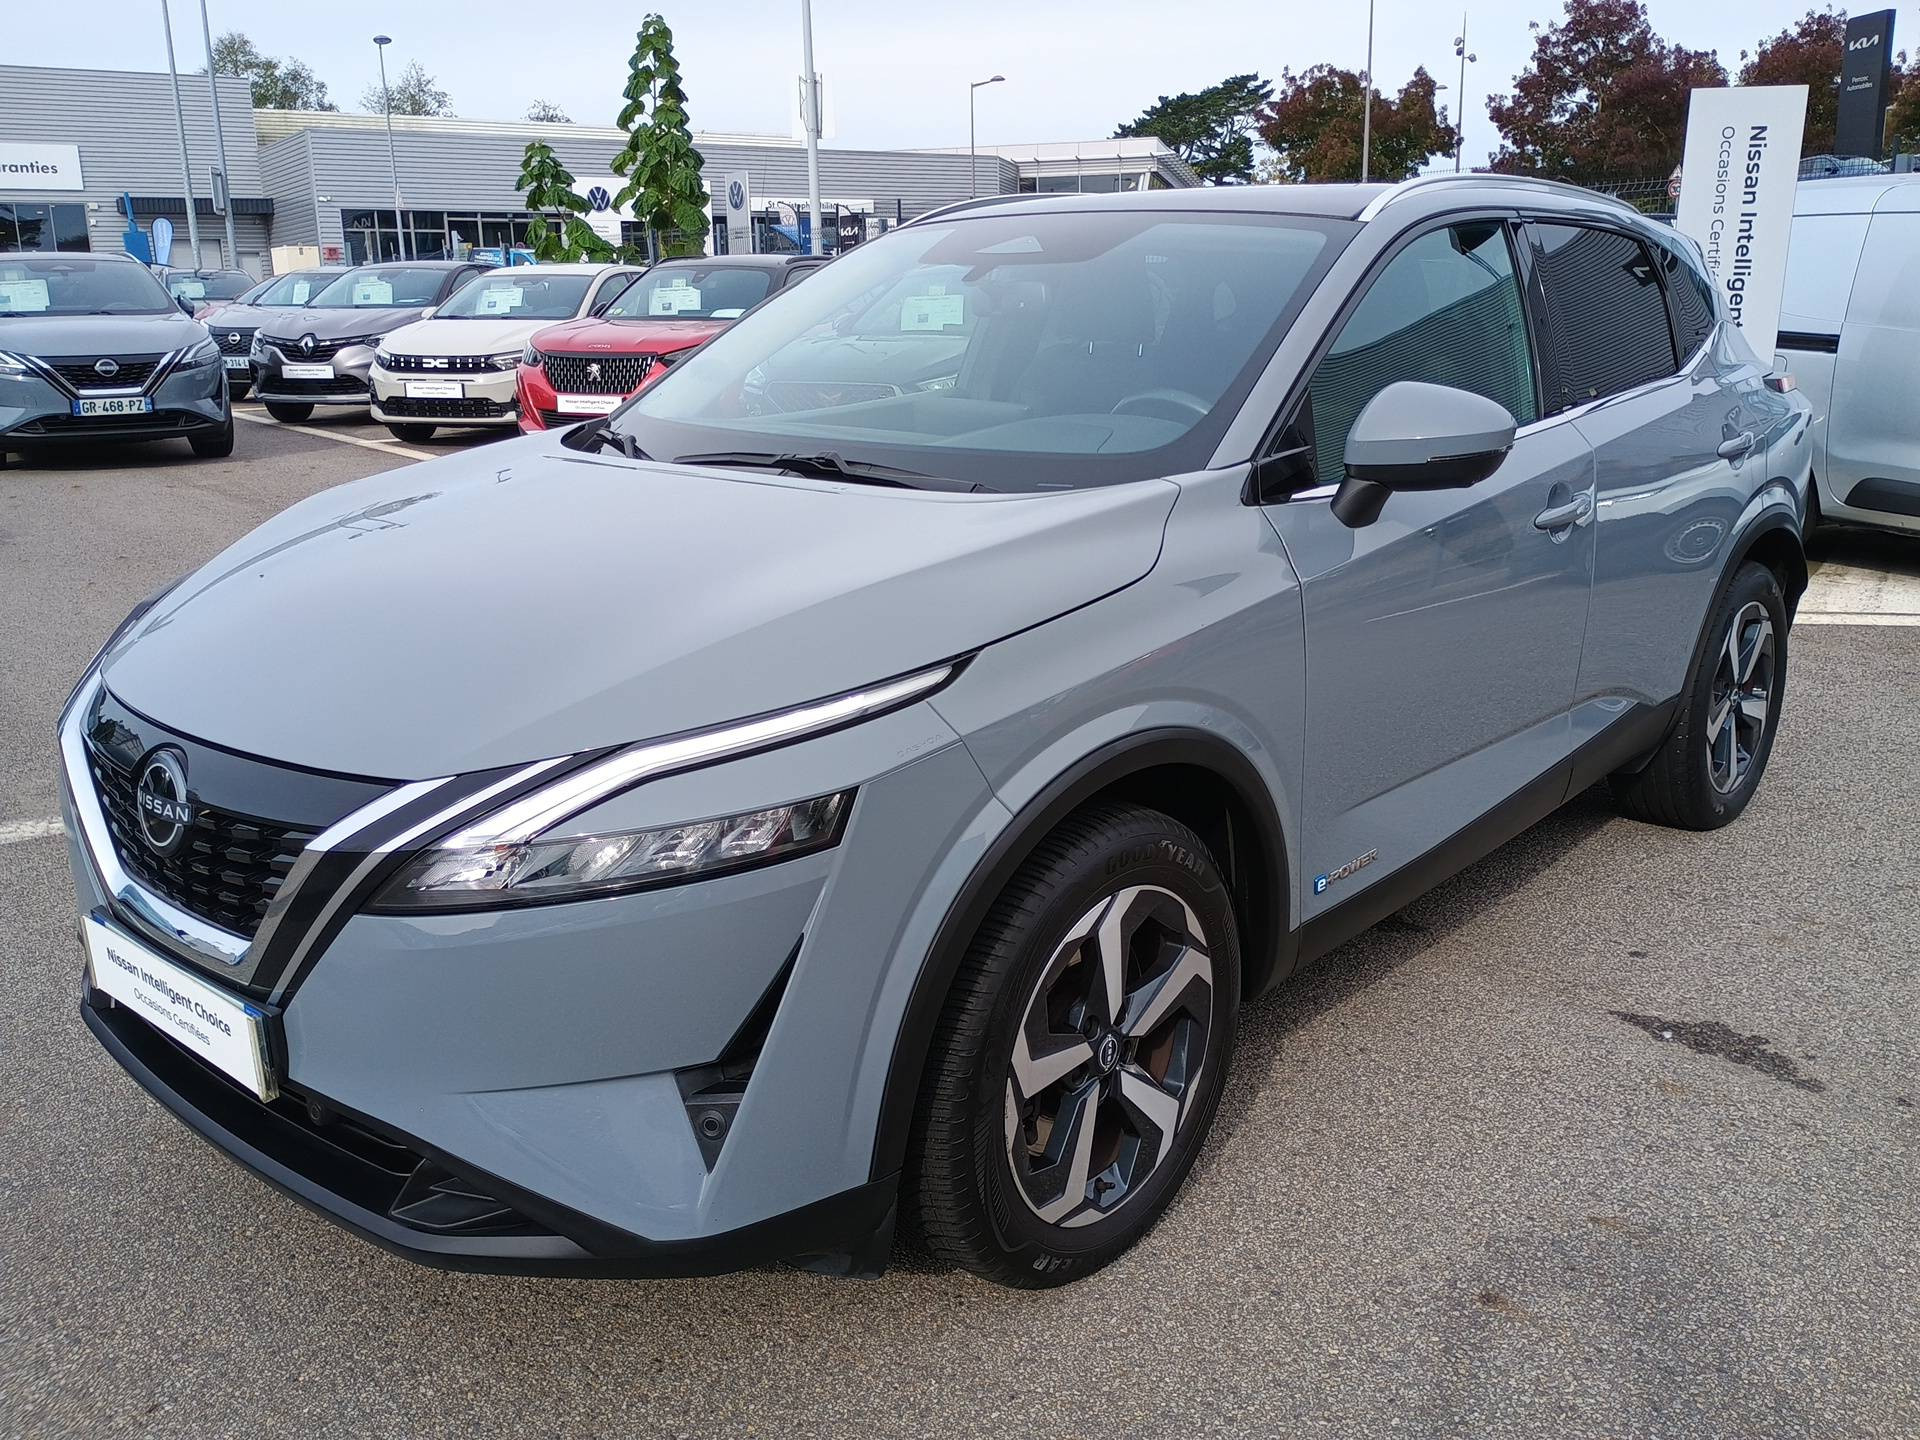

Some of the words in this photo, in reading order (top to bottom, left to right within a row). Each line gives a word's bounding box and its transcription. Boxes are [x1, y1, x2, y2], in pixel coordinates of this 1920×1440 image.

[0, 161, 58, 174] ranties
[1712, 126, 1736, 215] Occasions
[1742, 125, 1768, 205] Nissan
[82, 400, 144, 414] GR-468-PZ
[106, 946, 140, 979] Nissan
[140, 967, 194, 1013] Intelligent
[194, 1002, 232, 1038] Choice
[133, 987, 173, 1021] Occasions
[173, 1013, 211, 1046] Certifiées
